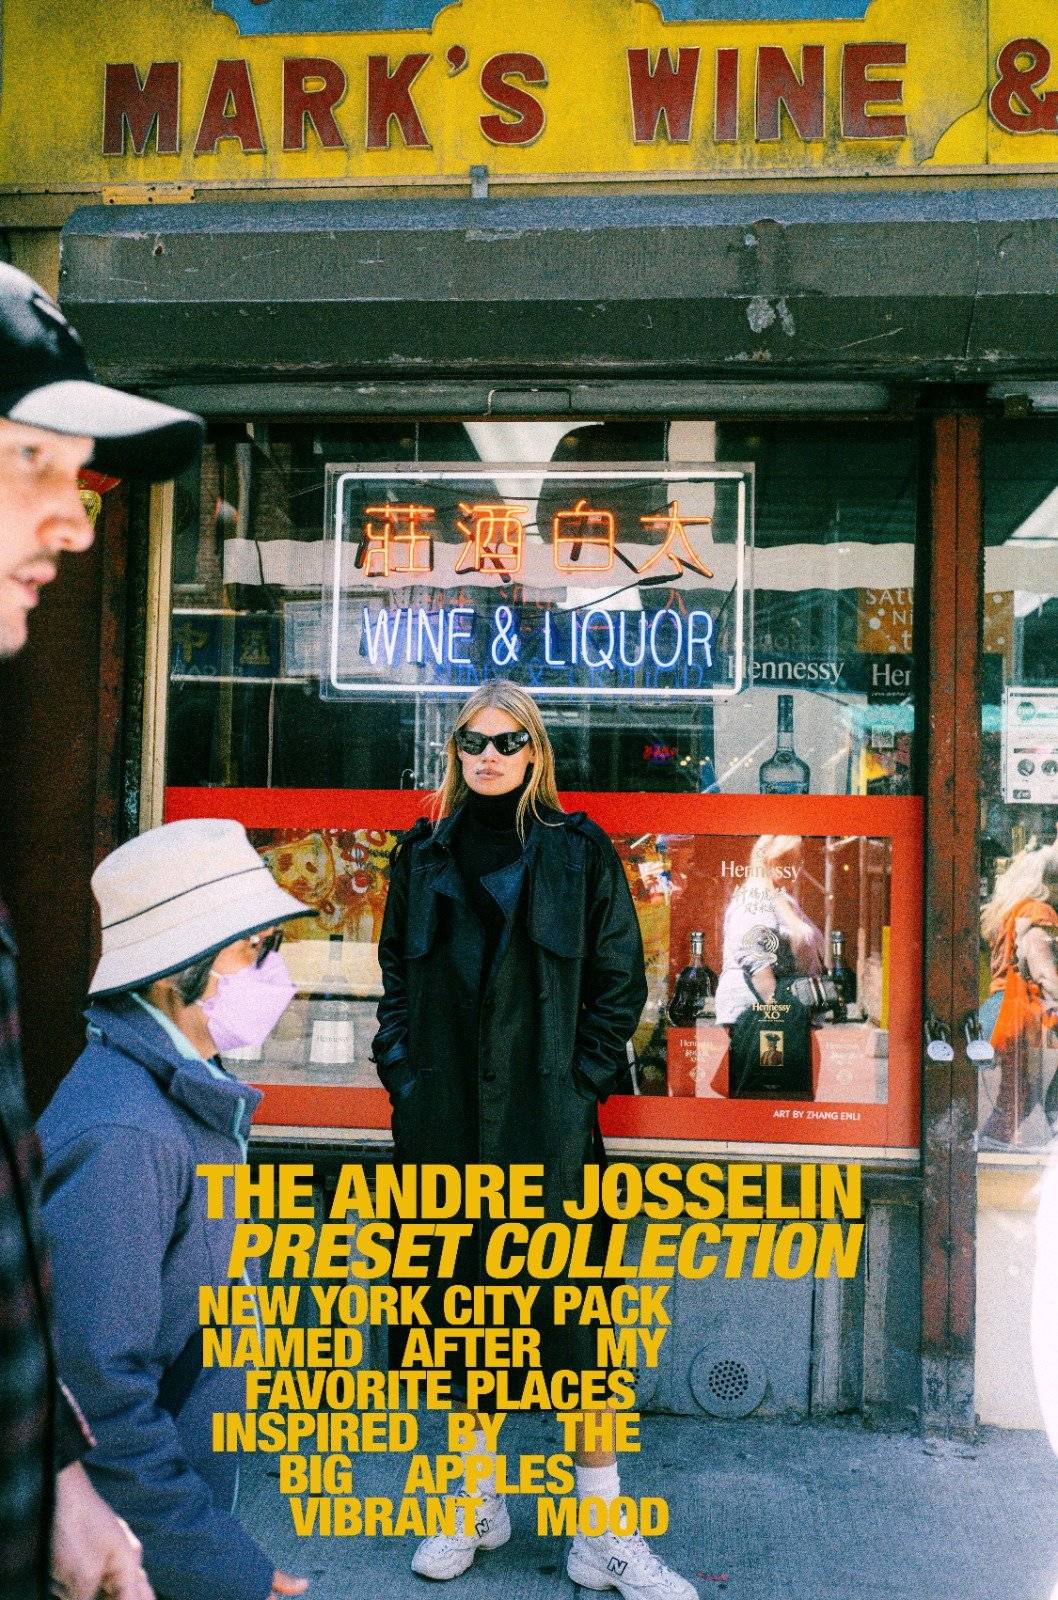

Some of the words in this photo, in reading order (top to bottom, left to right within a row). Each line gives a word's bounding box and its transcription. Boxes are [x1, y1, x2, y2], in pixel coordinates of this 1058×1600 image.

[102, 44, 549, 156] MARK'S
[628, 41, 908, 144] WINE
[988, 37, 1058, 136] &
[362, 607, 475, 666] WINE
[491, 605, 518, 665] &
[544, 608, 713, 669] LIQUOR
[772, 1109, 791, 1119] ART
[792, 1110, 804, 1119] BY
[806, 1110, 839, 1120] ZHANG
[840, 1111, 861, 1121] ENLI
